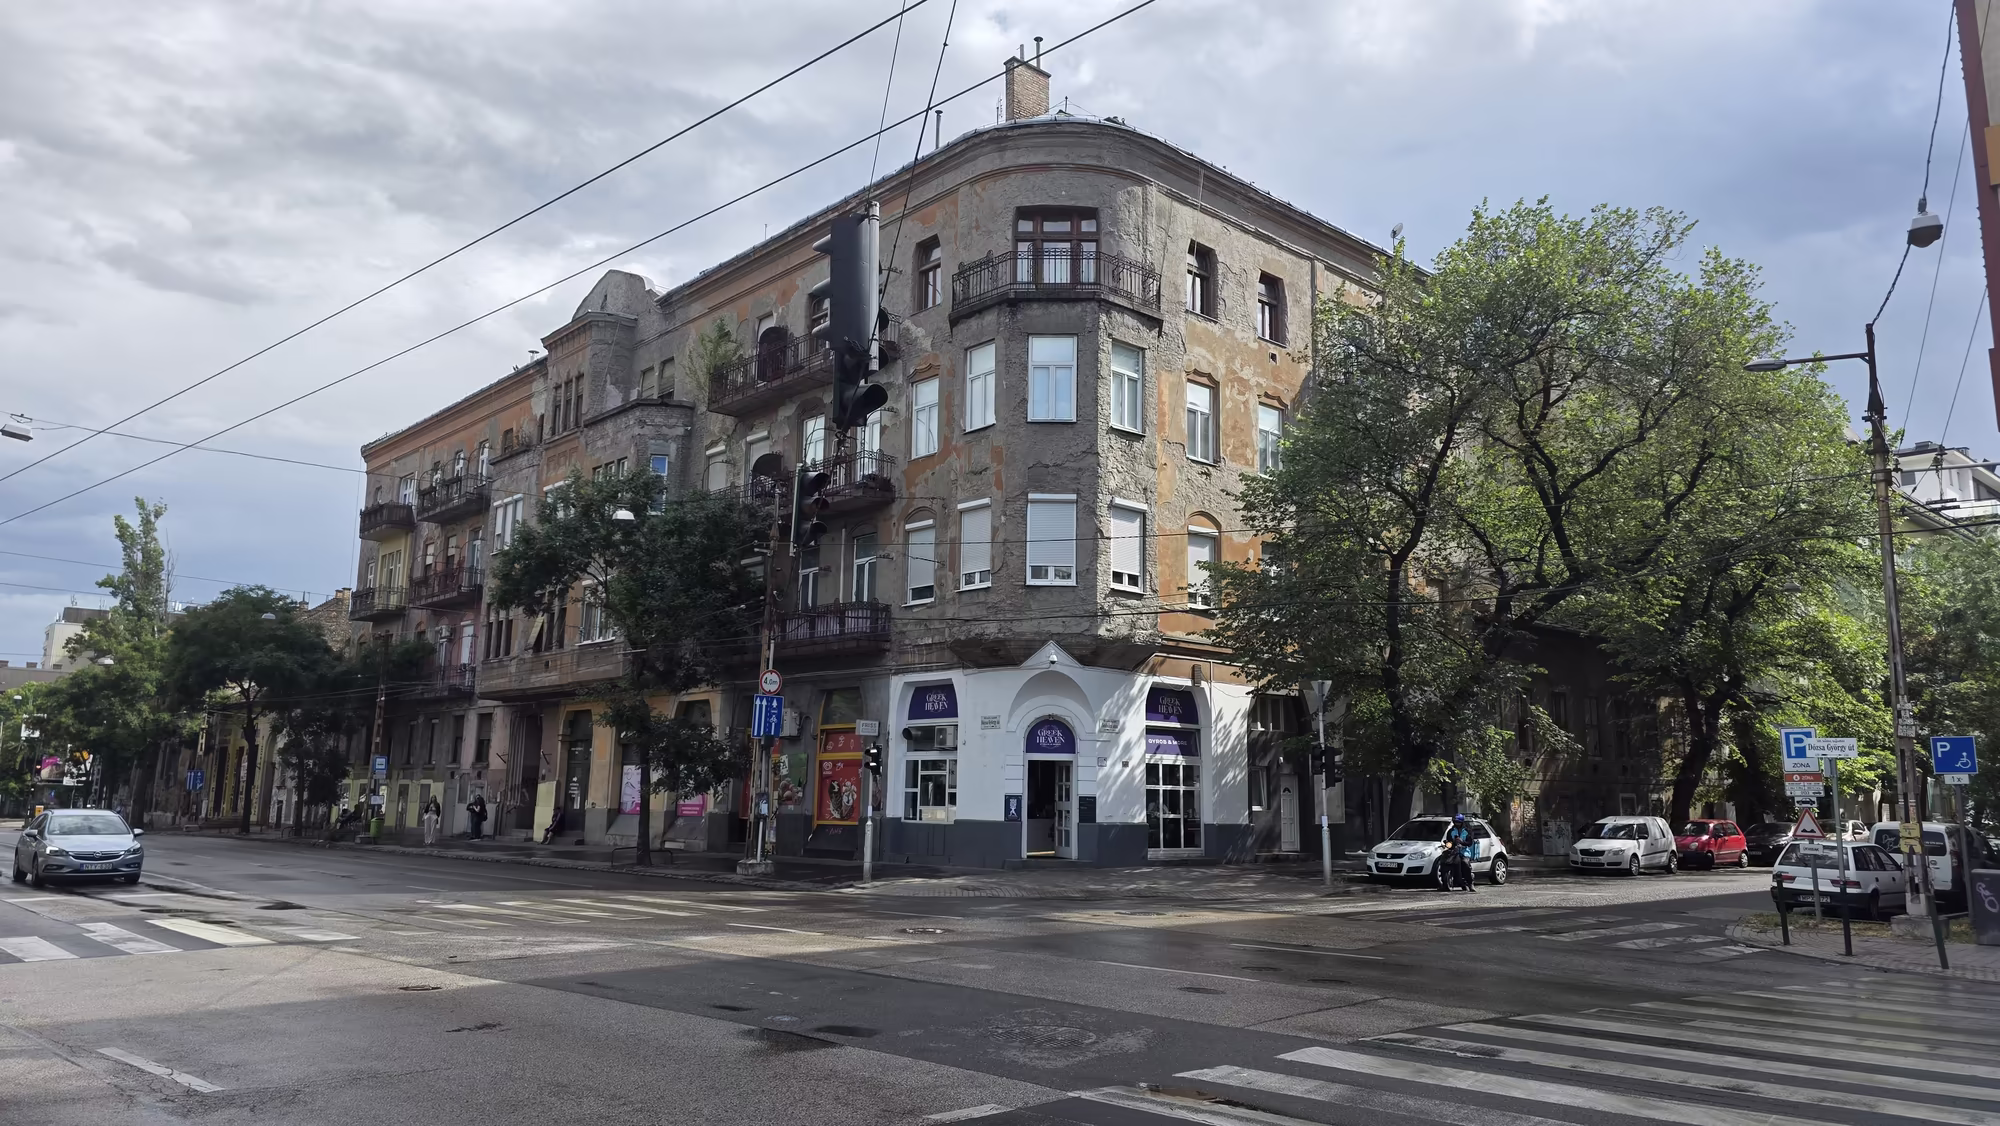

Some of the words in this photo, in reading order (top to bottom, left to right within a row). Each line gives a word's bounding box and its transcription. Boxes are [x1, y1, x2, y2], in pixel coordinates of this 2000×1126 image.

[925, 701, 948, 710] HEAVEN
[1037, 728, 1063, 738] GREEK
[1036, 736, 1065, 744] HEAVEN
[1789, 734, 1808, 757] P
[1808, 743, 1826, 752] Dózsa
[1826, 743, 1847, 754] György
[1847, 744, 1855, 752] út
[1936, 741, 1951, 758] P
